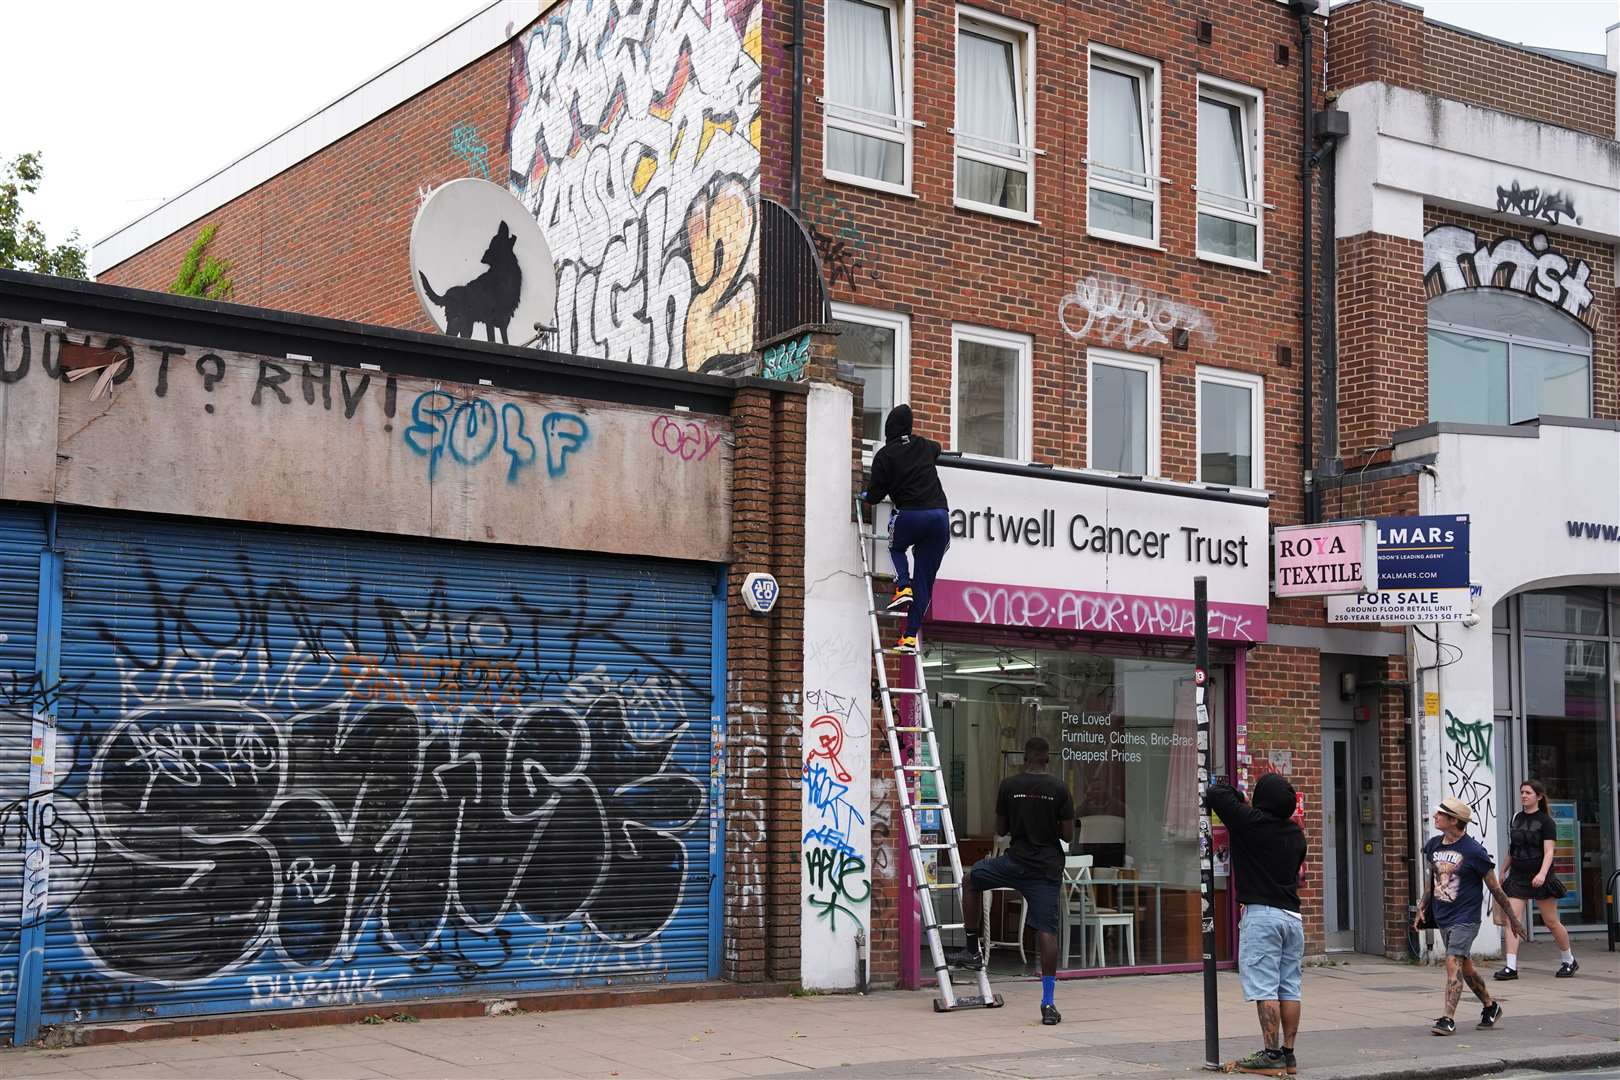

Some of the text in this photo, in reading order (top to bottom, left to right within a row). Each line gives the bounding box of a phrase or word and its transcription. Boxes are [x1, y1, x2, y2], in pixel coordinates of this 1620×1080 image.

[950, 507, 1248, 568] artwell Cancer Trust
[1377, 528, 1455, 544] LMARs
[1280, 536, 1346, 557] ROYA
[1280, 562, 1362, 586] TEXTILE
[1377, 572, 1437, 580] .KALMARS.COM
[1357, 592, 1439, 605] FOR SALE
[1061, 711, 1111, 726] Pre Loved
[1061, 729, 1193, 746] Furniture, Clothes, Bric-Brac
[1061, 747, 1142, 763] Cheapest Prices
